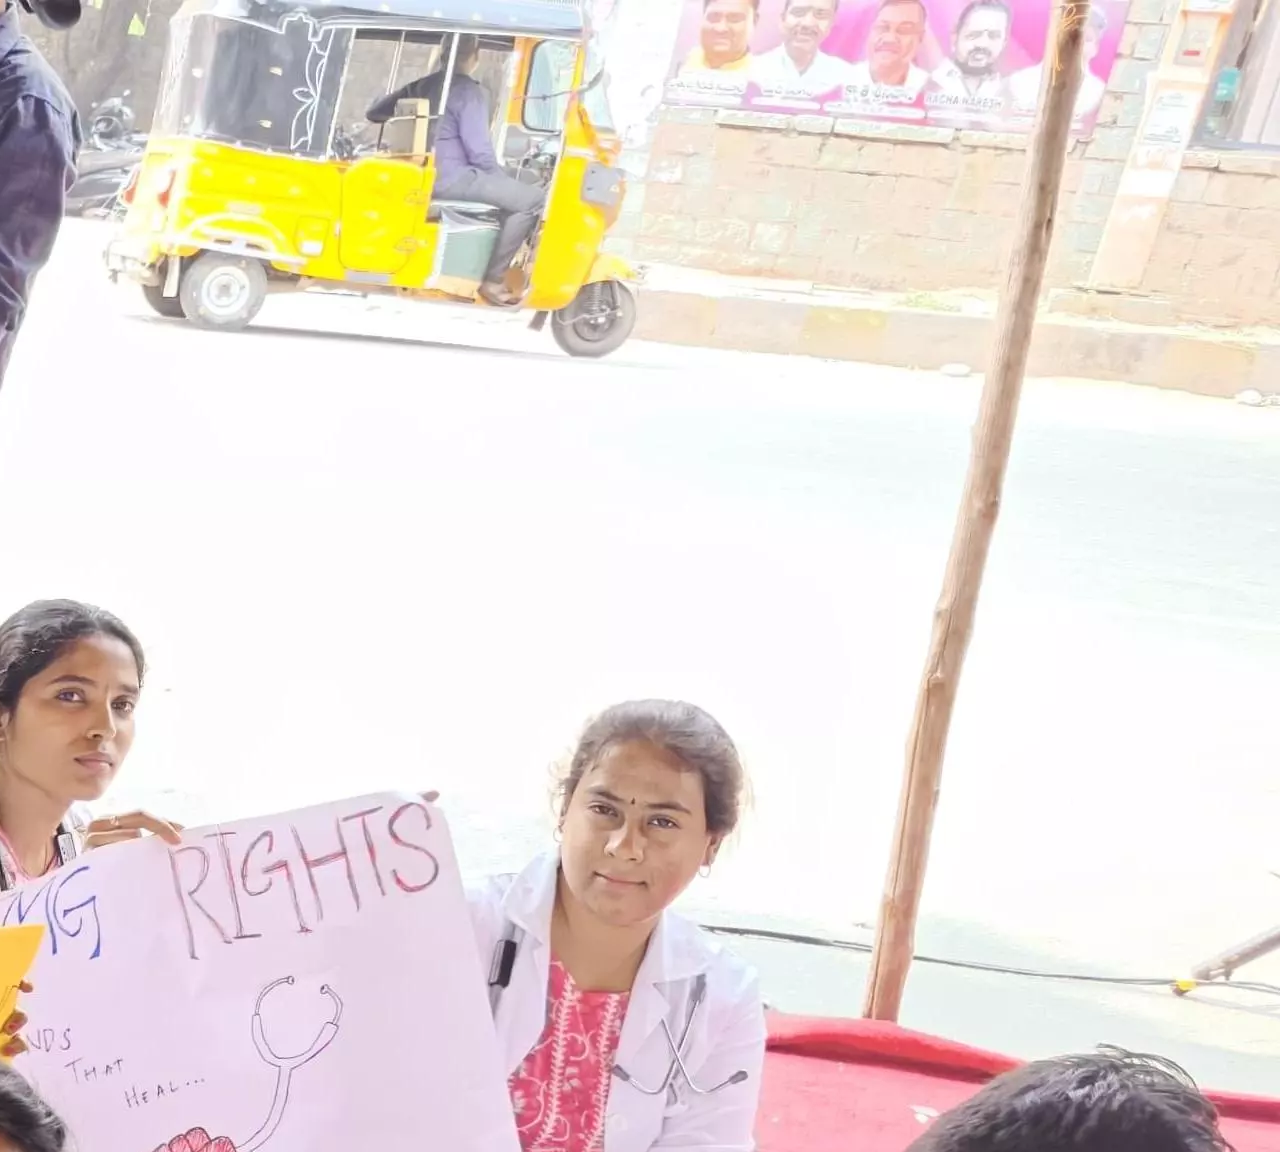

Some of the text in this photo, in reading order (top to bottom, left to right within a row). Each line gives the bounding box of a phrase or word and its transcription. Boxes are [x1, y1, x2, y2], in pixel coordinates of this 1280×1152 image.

[167, 801, 440, 961] RIGHTS
[26, 1027, 72, 1052] NDS
[64, 1056, 124, 1084] THAT
